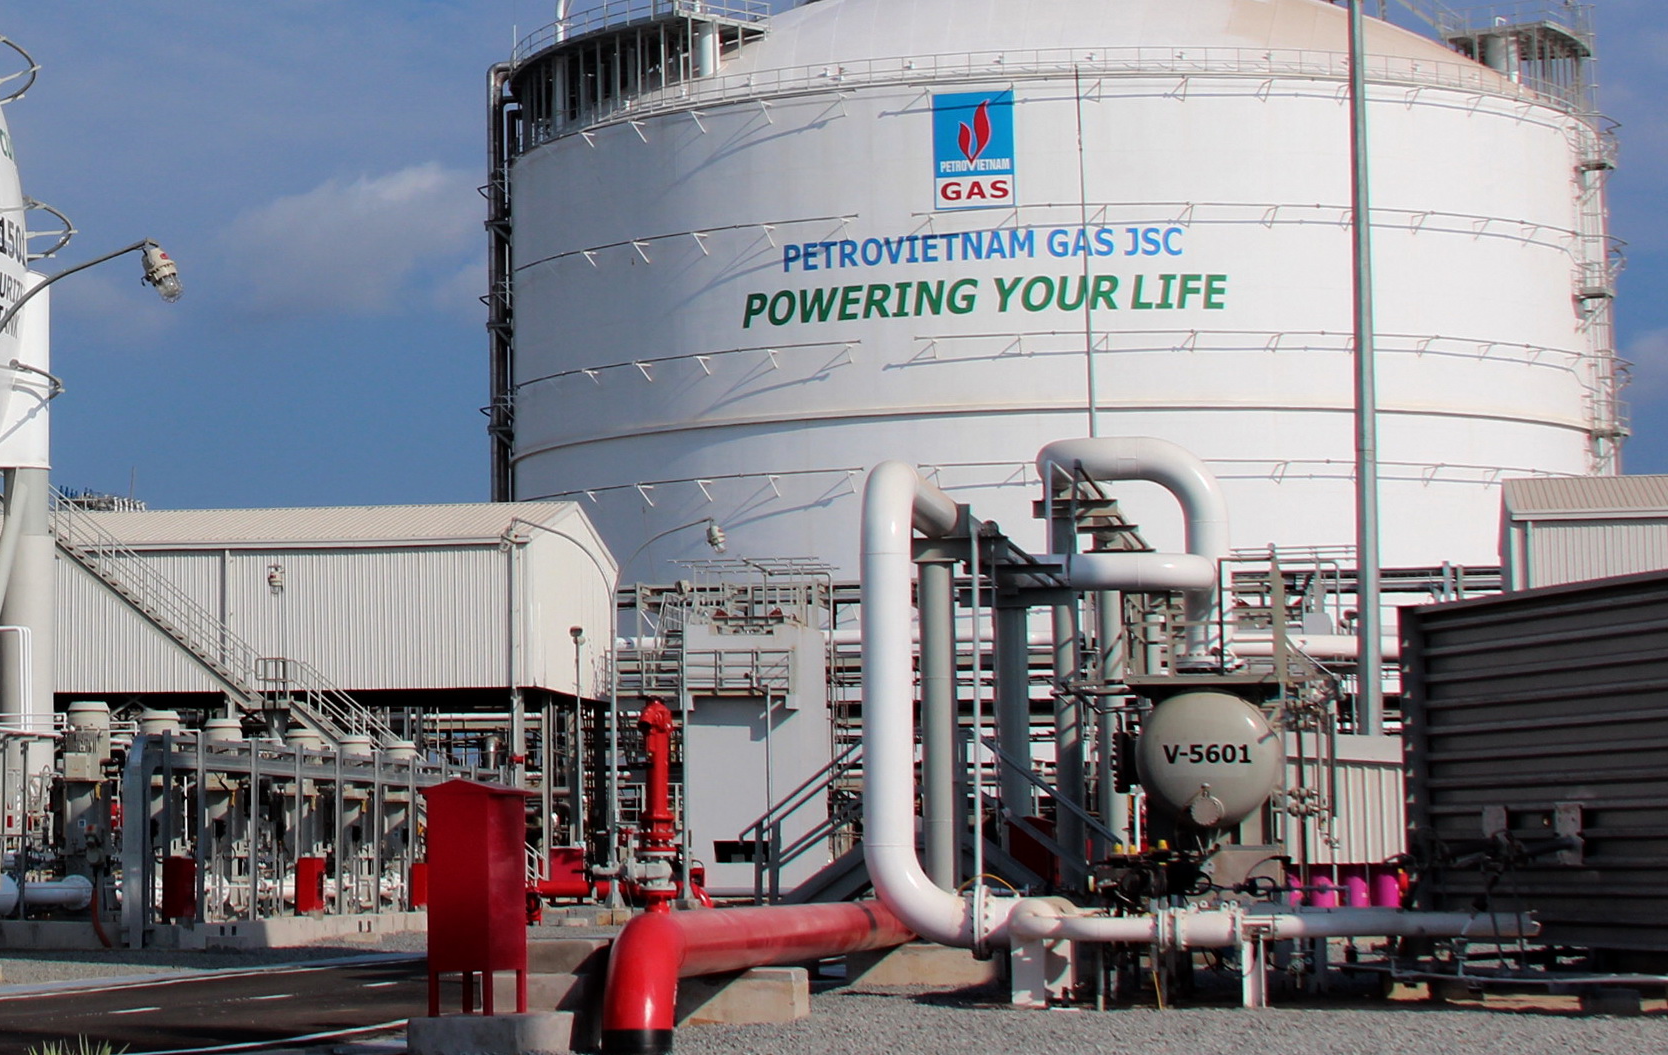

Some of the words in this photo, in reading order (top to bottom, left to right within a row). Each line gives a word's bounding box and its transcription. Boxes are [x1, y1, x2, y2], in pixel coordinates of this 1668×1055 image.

[940, 158, 1011, 173] PETROVIETNAM
[941, 180, 1009, 200] GAS
[783, 229, 1034, 273] PETROVIETNAM
[1046, 228, 1114, 257] GAS
[1123, 227, 1183, 257] JSC
[742, 278, 978, 329] POWERING
[993, 275, 1120, 313] YOUR
[1131, 274, 1228, 310] LIFE
[1162, 744, 1252, 764] V-5601
